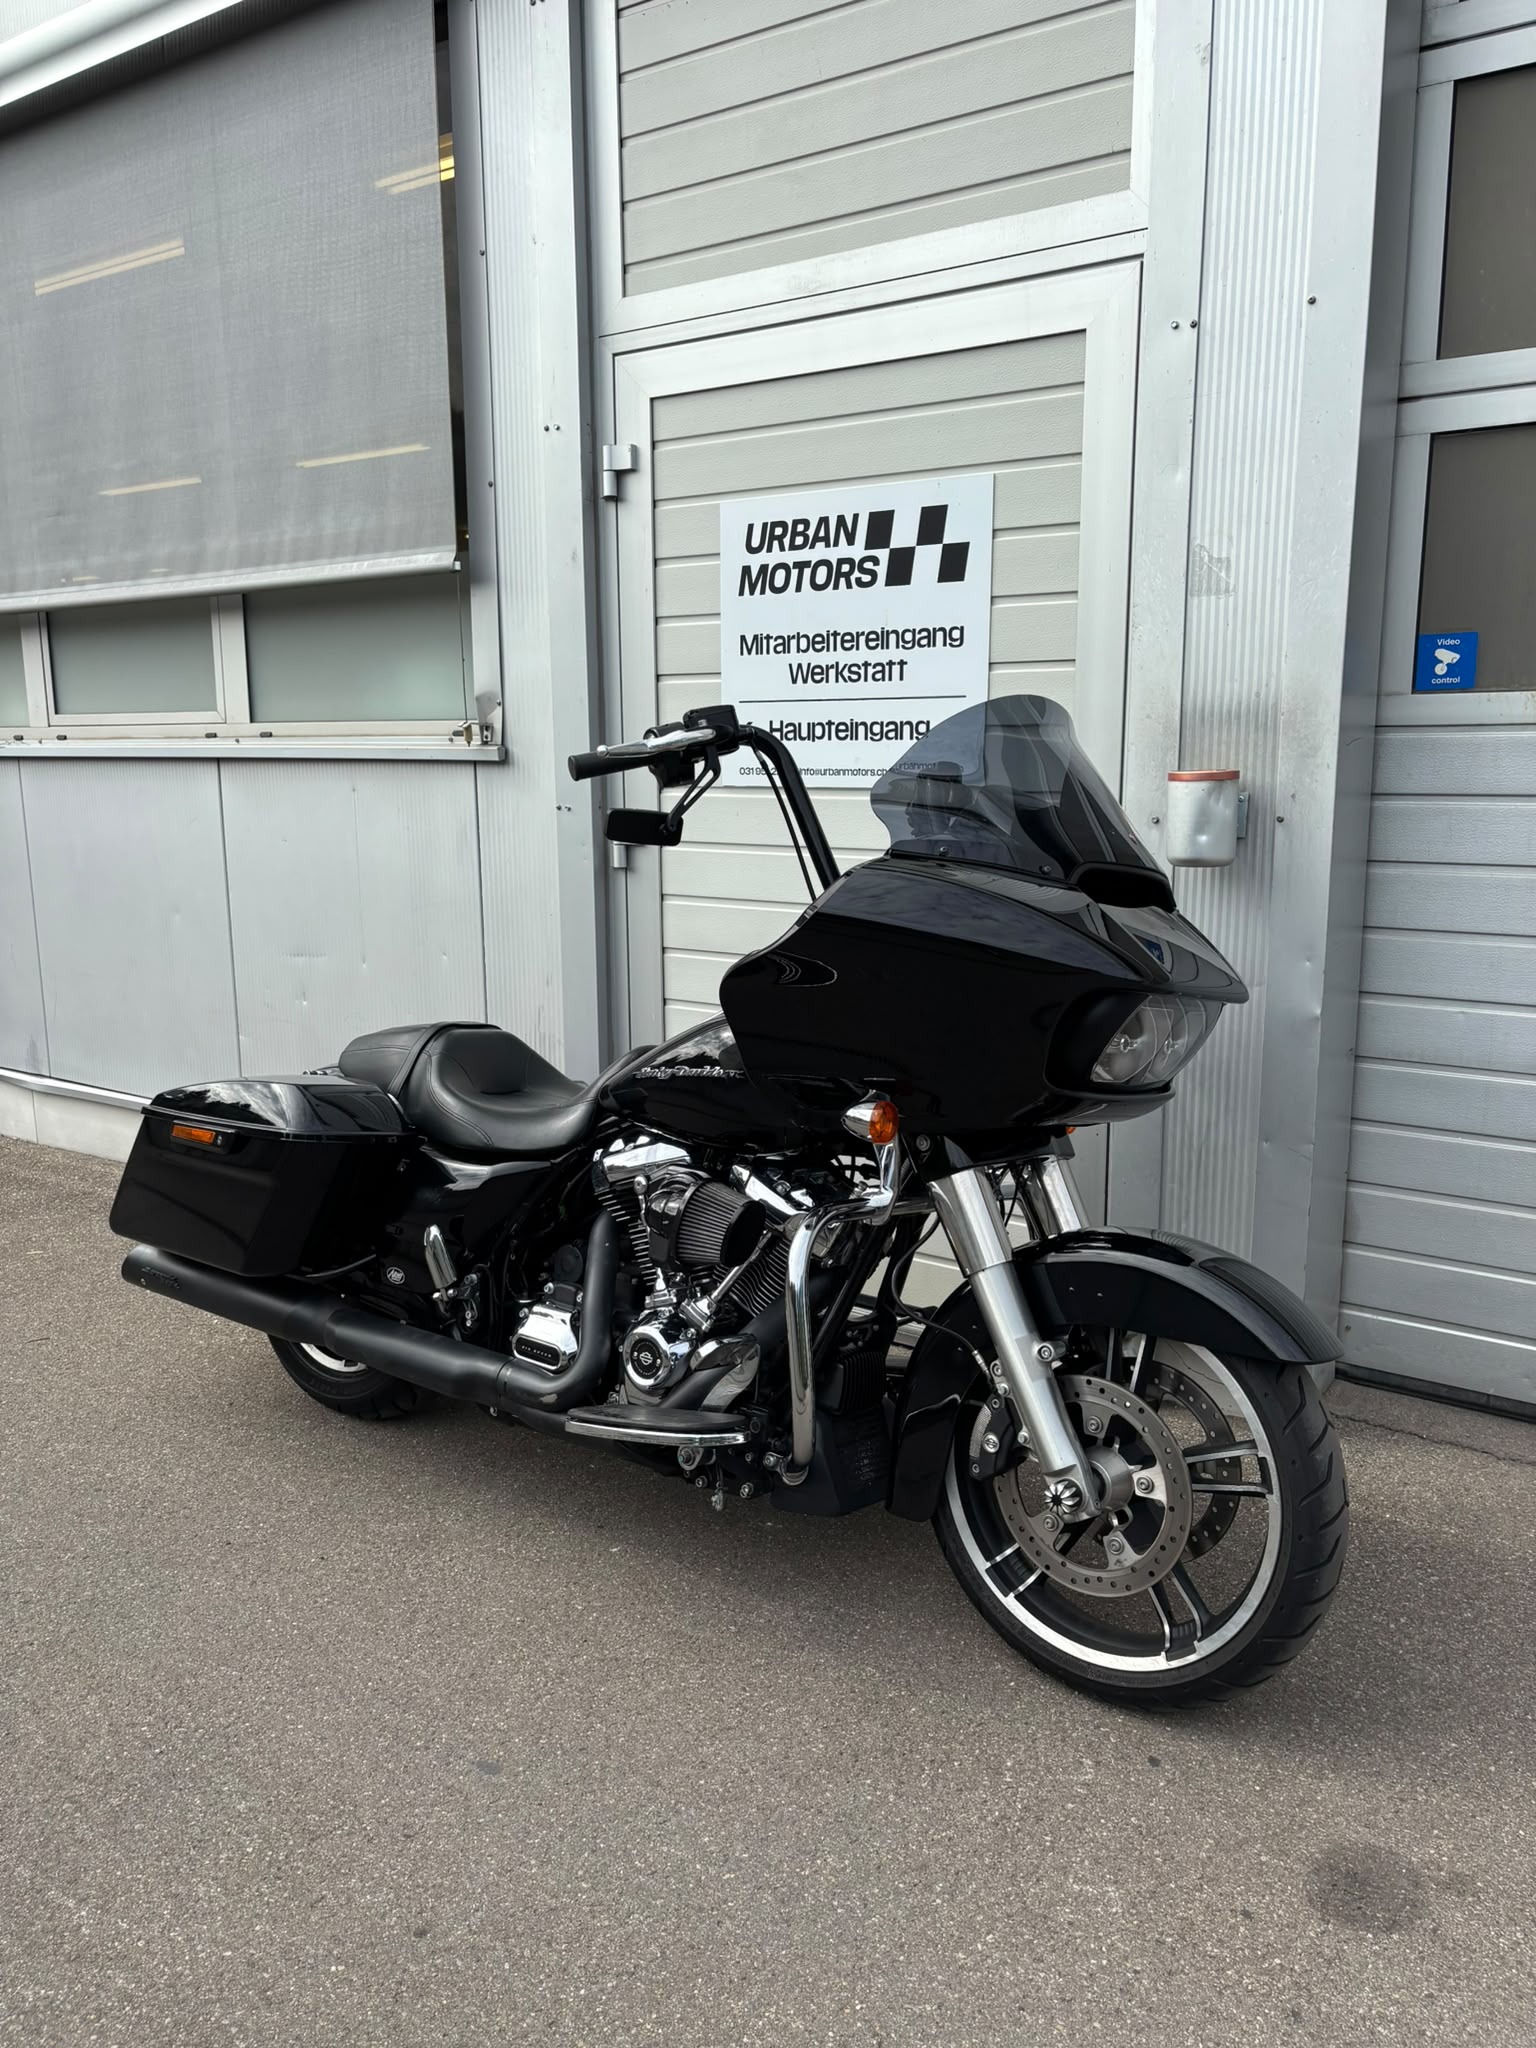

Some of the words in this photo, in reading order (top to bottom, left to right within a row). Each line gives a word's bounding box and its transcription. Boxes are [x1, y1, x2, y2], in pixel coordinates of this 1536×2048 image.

[745, 512, 860, 555] URBAN
[738, 554, 881, 597] MOTORS
[739, 625, 965, 657] Mitarbeitereingang
[1436, 638, 1462, 646] Video
[788, 658, 908, 685] Werkstatt
[1431, 676, 1461, 685] control
[769, 718, 931, 743] Haupteingang
